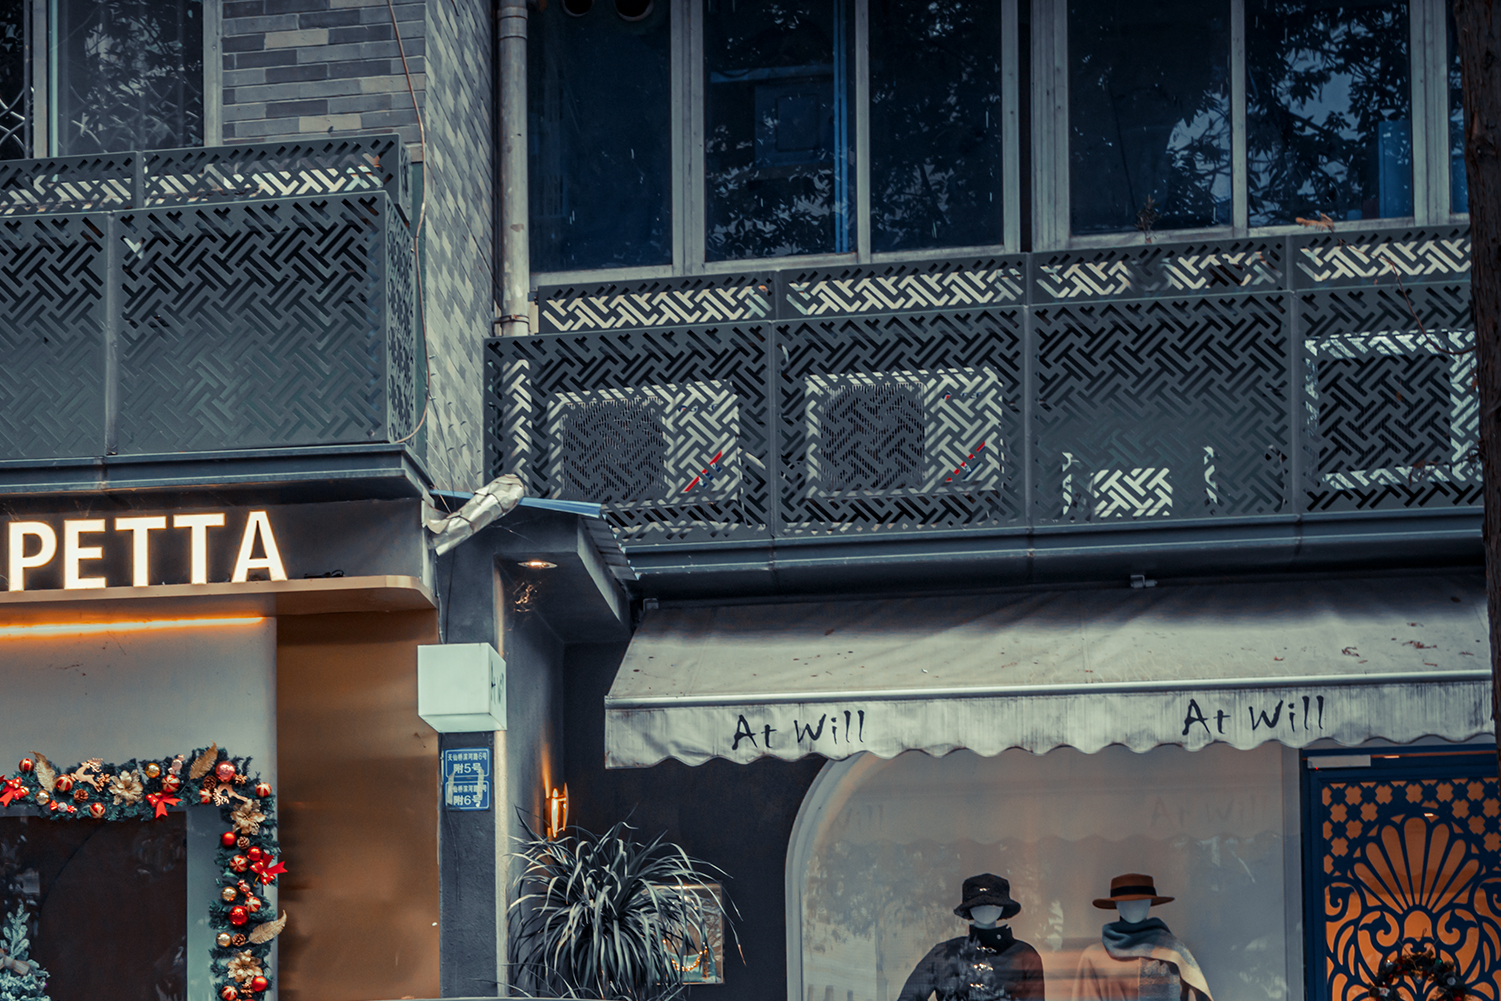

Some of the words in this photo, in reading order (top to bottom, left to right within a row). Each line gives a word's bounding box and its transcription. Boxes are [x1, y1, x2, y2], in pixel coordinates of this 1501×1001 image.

[731, 714, 777, 750] At
[794, 710, 865, 744] Will
[1182, 699, 1231, 735] At
[1248, 695, 1324, 732] Will
